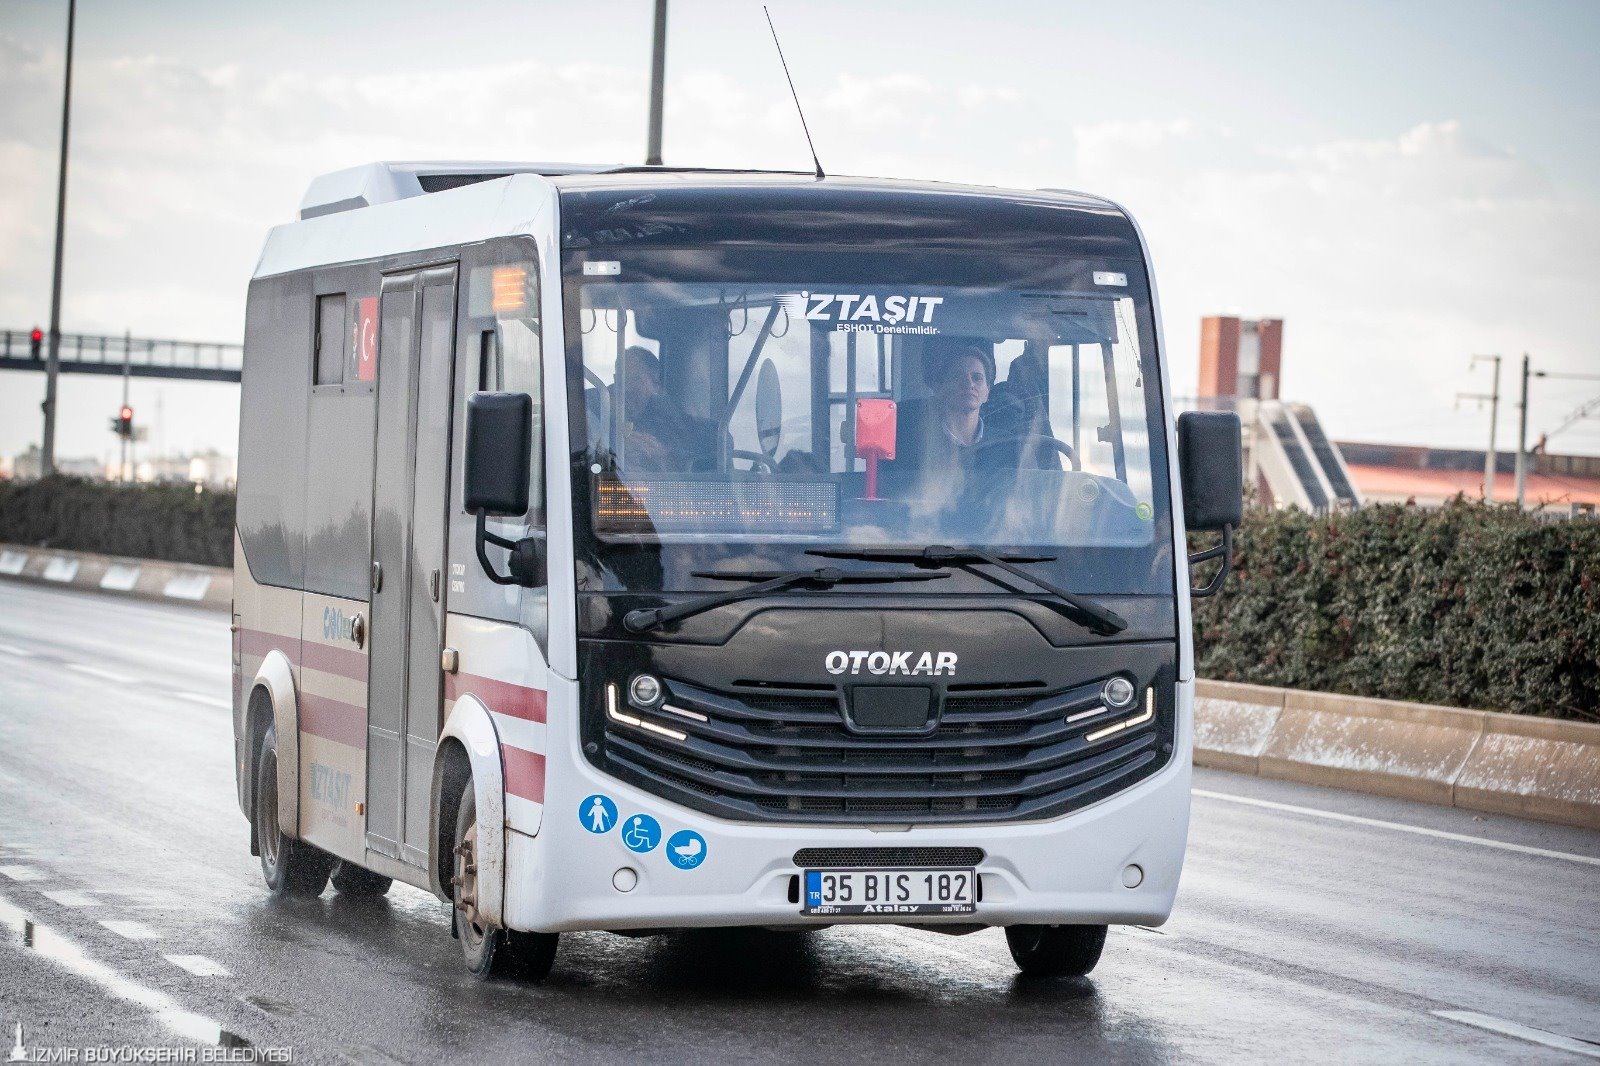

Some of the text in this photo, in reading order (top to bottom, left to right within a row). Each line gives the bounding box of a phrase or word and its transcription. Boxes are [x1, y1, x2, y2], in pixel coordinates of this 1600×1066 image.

[799, 290, 944, 325] İZTAŞIT
[836, 323, 874, 333] ESHOT
[825, 650, 958, 676] OTOKAR
[809, 891, 821, 900] TR
[823, 874, 967, 902] 35 BIS 182
[862, 904, 920, 913] Atalay
